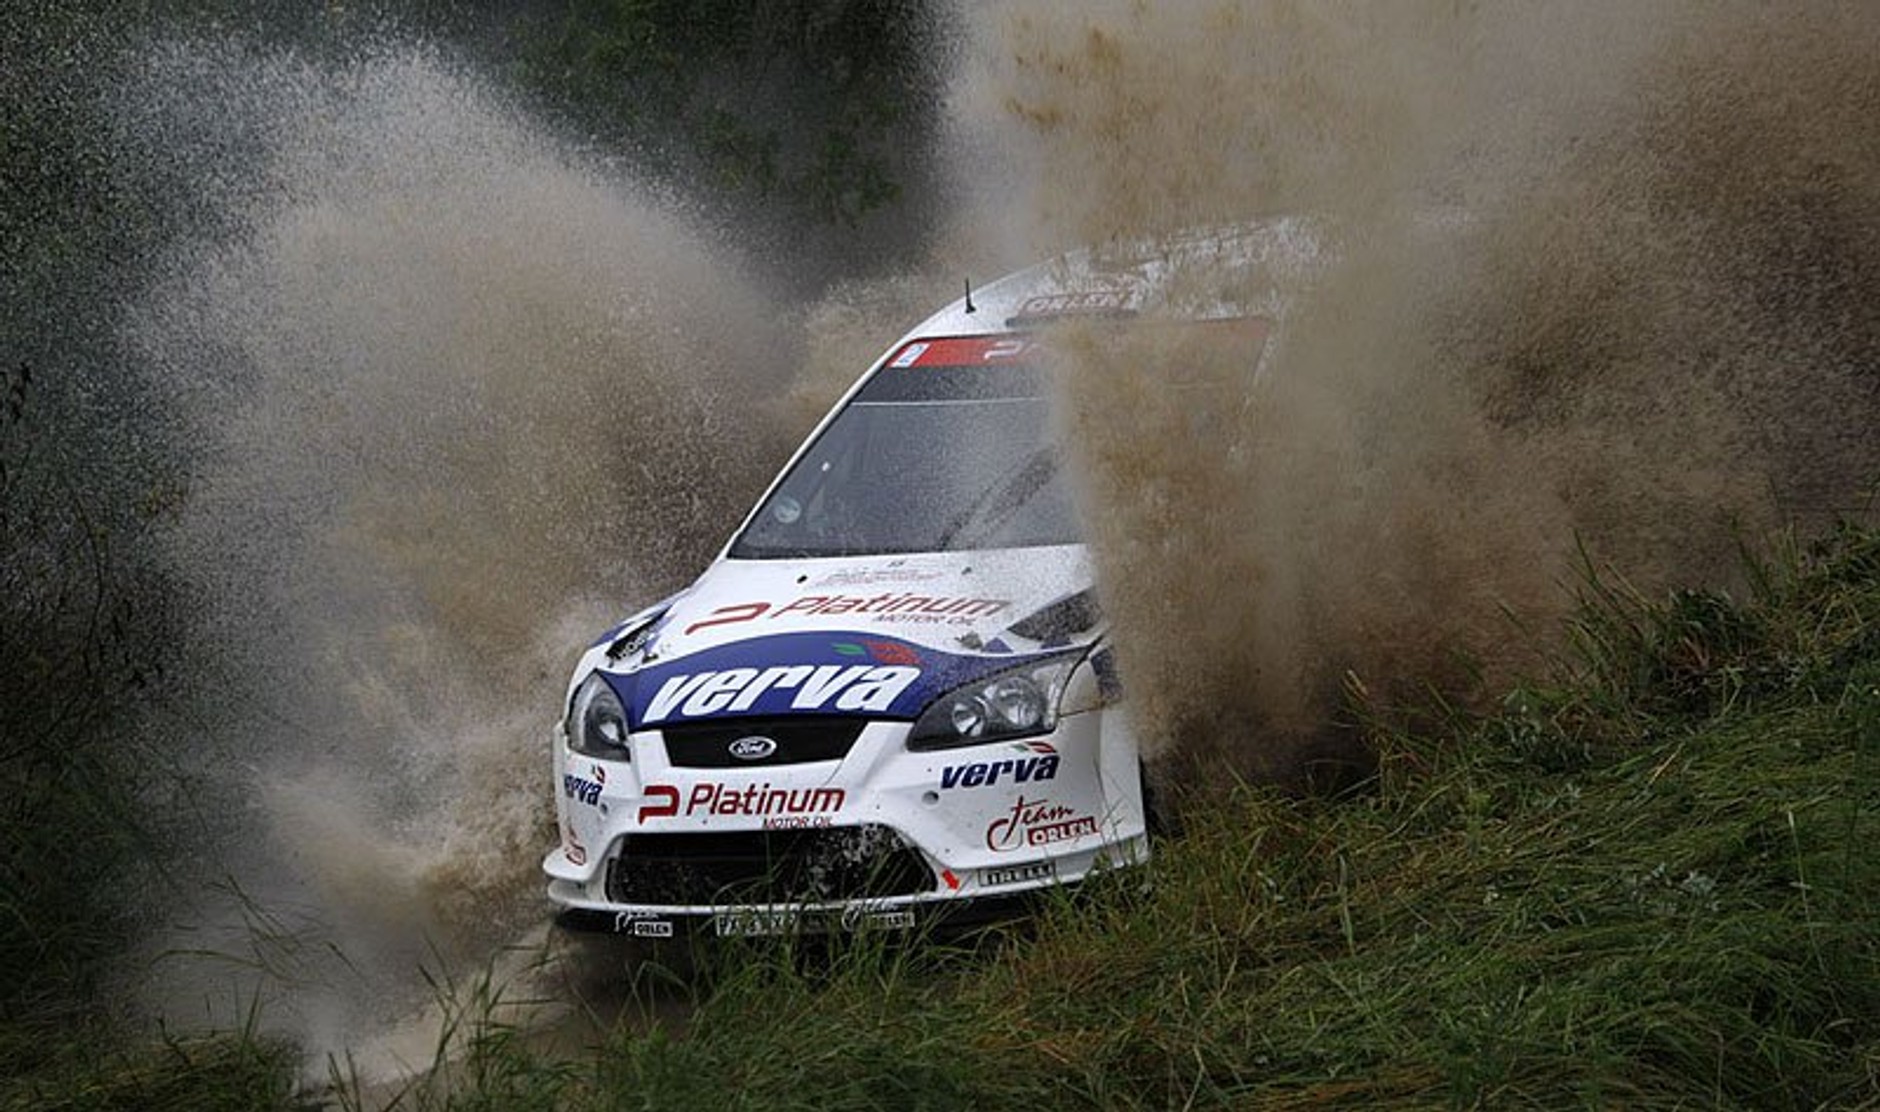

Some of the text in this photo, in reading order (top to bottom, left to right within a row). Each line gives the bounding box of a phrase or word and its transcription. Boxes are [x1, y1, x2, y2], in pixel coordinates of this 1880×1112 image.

[770, 592, 1009, 619] Platinum
[642, 663, 922, 723] verva
[940, 753, 1061, 790] verva
[686, 782, 846, 816] Platinum
[762, 816, 810, 830] MOTOR
[1030, 820, 1094, 843] ORLEN
